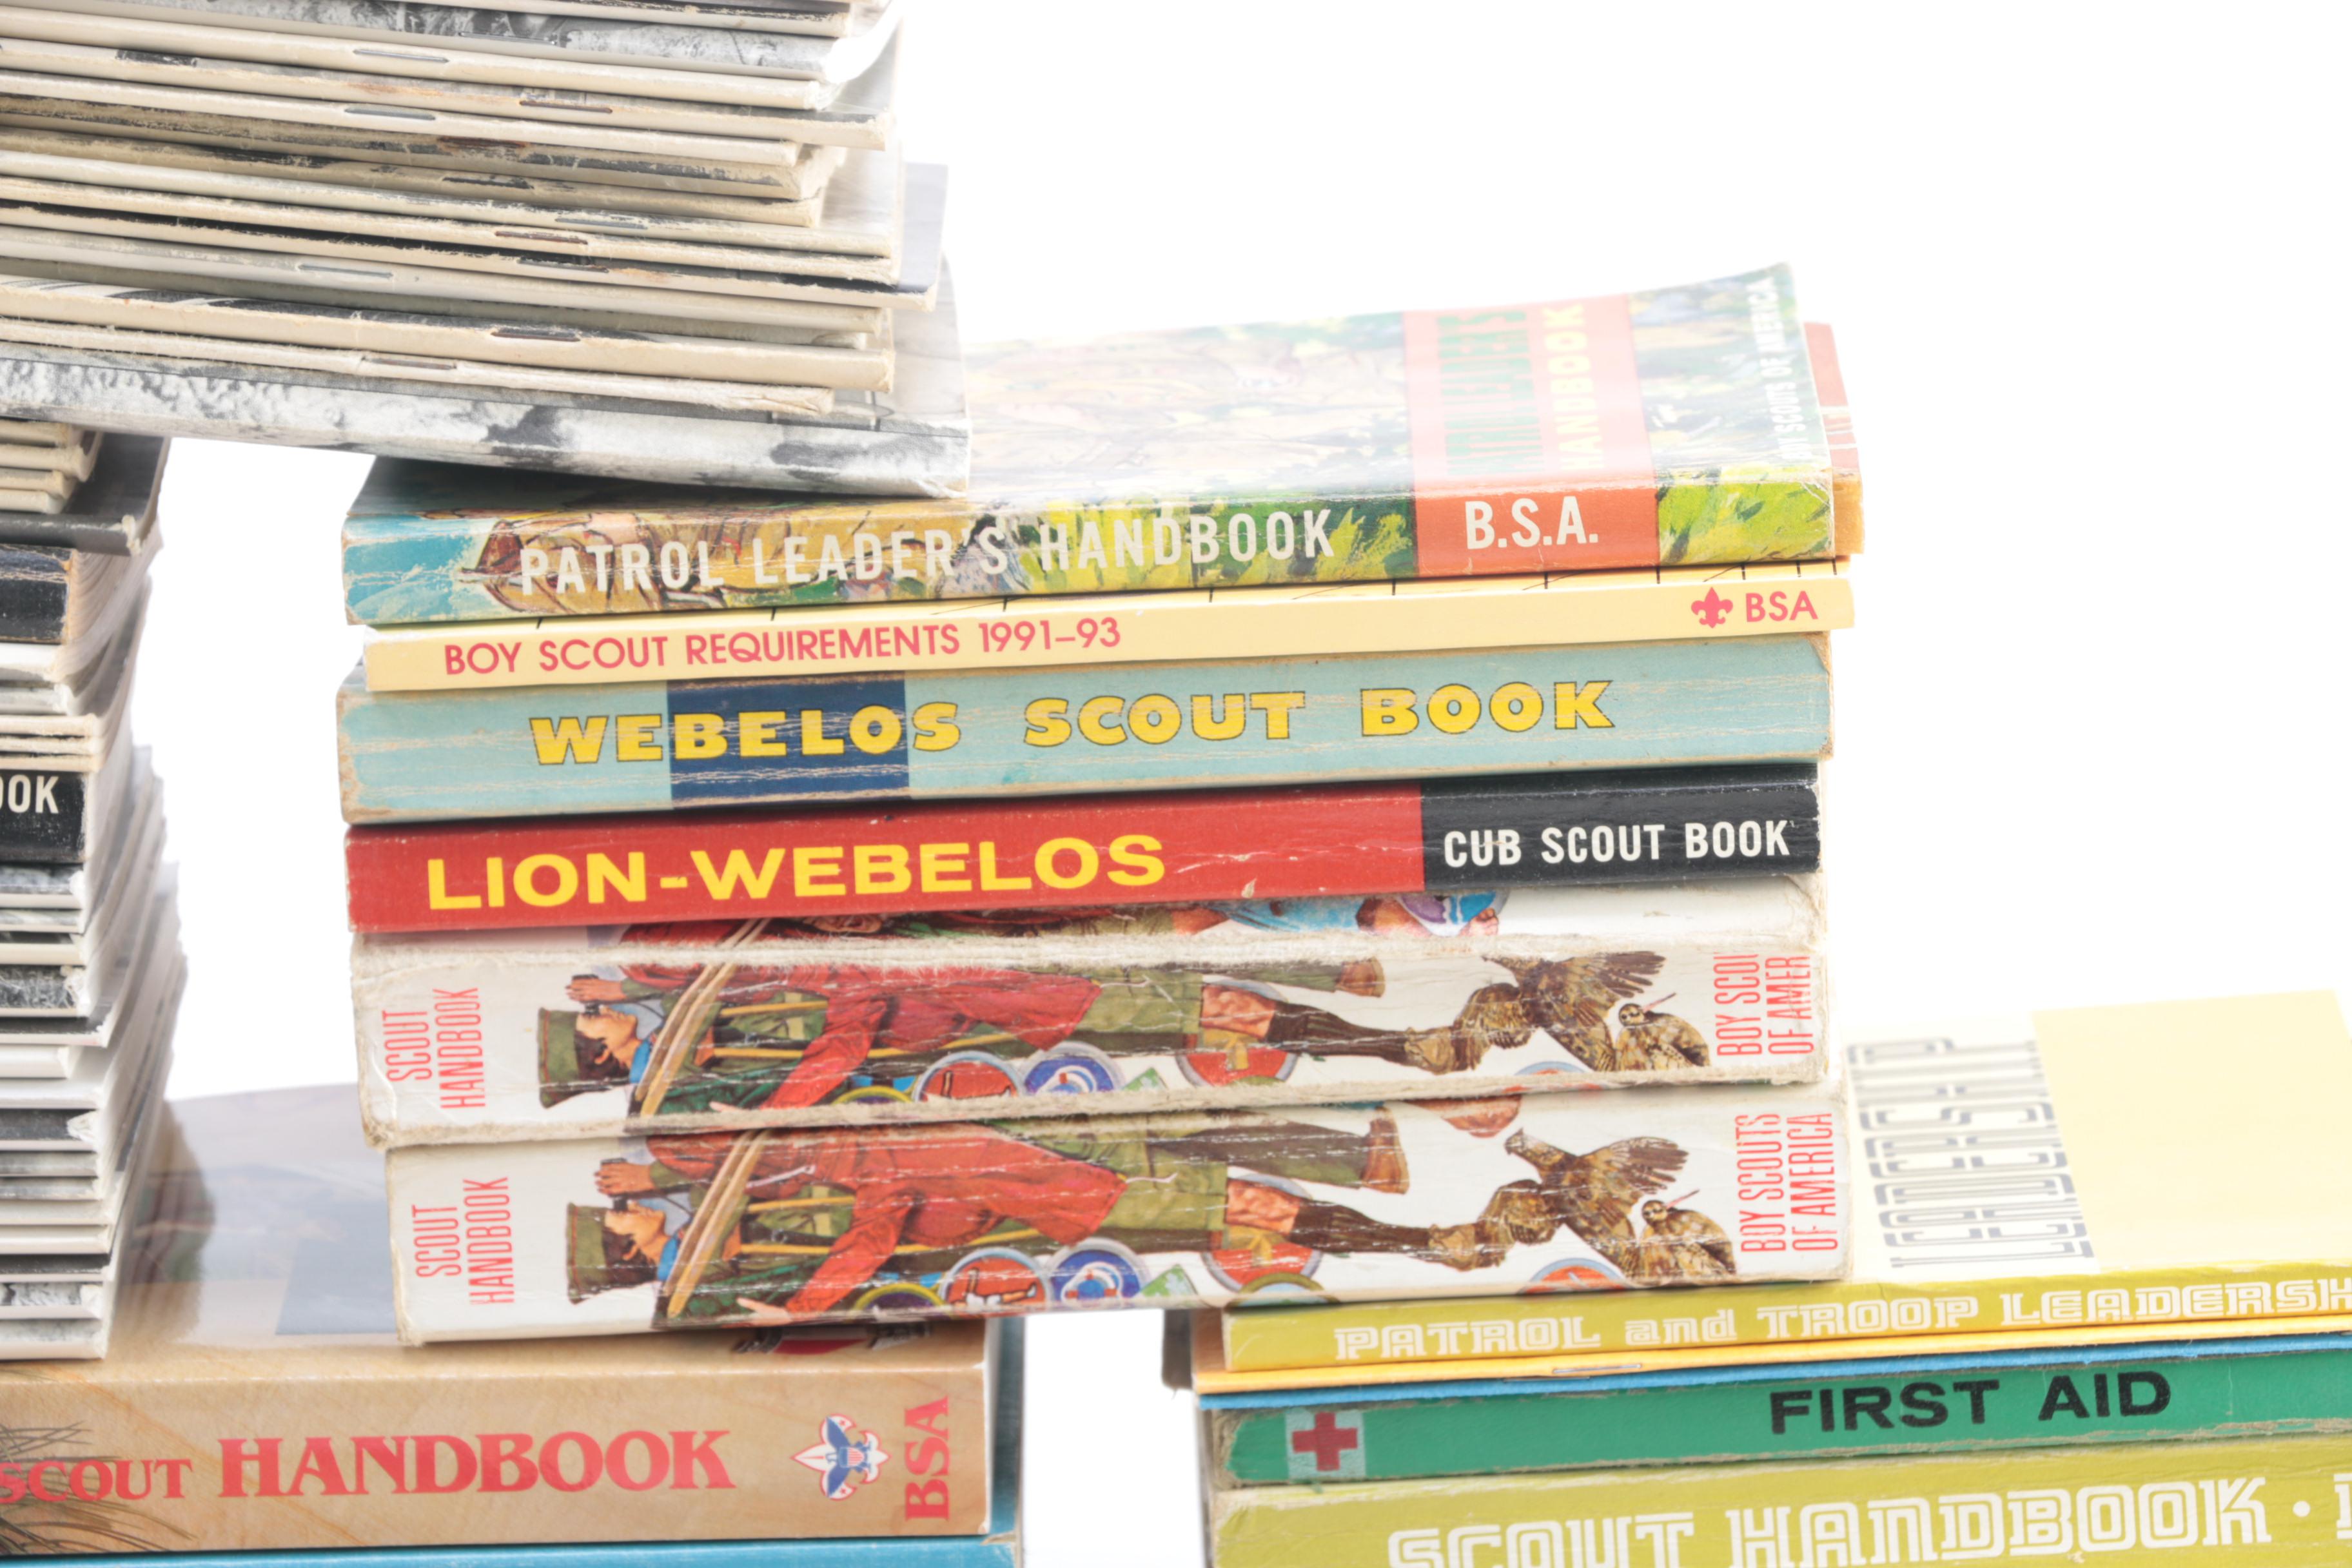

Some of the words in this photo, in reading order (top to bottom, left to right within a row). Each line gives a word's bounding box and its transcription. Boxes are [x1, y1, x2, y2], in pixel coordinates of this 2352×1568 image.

[1745, 277, 1786, 351] AMERICA
[1542, 304, 1605, 471] HANDBOOK
[1759, 358, 1792, 377] OF
[1443, 406, 1545, 476] PATROL
[1765, 382, 1806, 432] SCOUTS
[520, 540, 725, 596] PATROL
[752, 525, 1008, 585] LEADER'S
[1039, 507, 1333, 571] HANDBOOK
[1464, 495, 1599, 549] B.S.A.
[1745, 591, 1818, 623] BSA
[445, 642, 522, 674] BOY
[539, 636, 669, 672] SCOUT
[686, 623, 960, 665] REQUIREMENTS
[978, 616, 1121, 652] 1991–93
[529, 701, 962, 765] WEBELOS
[1023, 692, 1306, 747] SCOUT
[1360, 680, 1616, 736] BOOK
[0, 774, 59, 814] OK
[427, 834, 1166, 910] LION-WEBELOS
[1444, 829, 1522, 867] CUB
[1540, 823, 1665, 863] SCOUT
[1685, 819, 1790, 859] BOOK
[1765, 955, 1812, 1020] AMER
[382, 1009, 433, 1083] SCOUT
[433, 987, 486, 1110] HANDBOOK
[1714, 1014, 1763, 1056] BOY
[1768, 1030, 1814, 1056] OF
[1734, 1113, 1784, 1200] SCOUTS
[1787, 1112, 1837, 1217] AMERICA
[1846, 1037, 2095, 1269] LEADERSHIP
[412, 1204, 462, 1277] SCOUT
[463, 1177, 514, 1306] HANDBOOK
[1740, 1210, 1787, 1252] BOY
[1792, 1224, 1839, 1251] OF
[1334, 1316, 1601, 1360] PATROL
[1625, 1309, 1737, 1344] and
[1757, 1296, 1979, 1340] TROOP
[2000, 1277, 2352, 1326] LEADERSH
[1769, 1380, 2000, 1435] FIRST
[2037, 1371, 2171, 1421] AID
[0, 1458, 192, 1504] SCOUT
[217, 1429, 737, 1498] HANDBOOK
[904, 1395, 951, 1522] BSA
[1388, 1512, 1694, 1568] SCOUT
[1725, 1476, 2272, 1568] HANDBOOK
